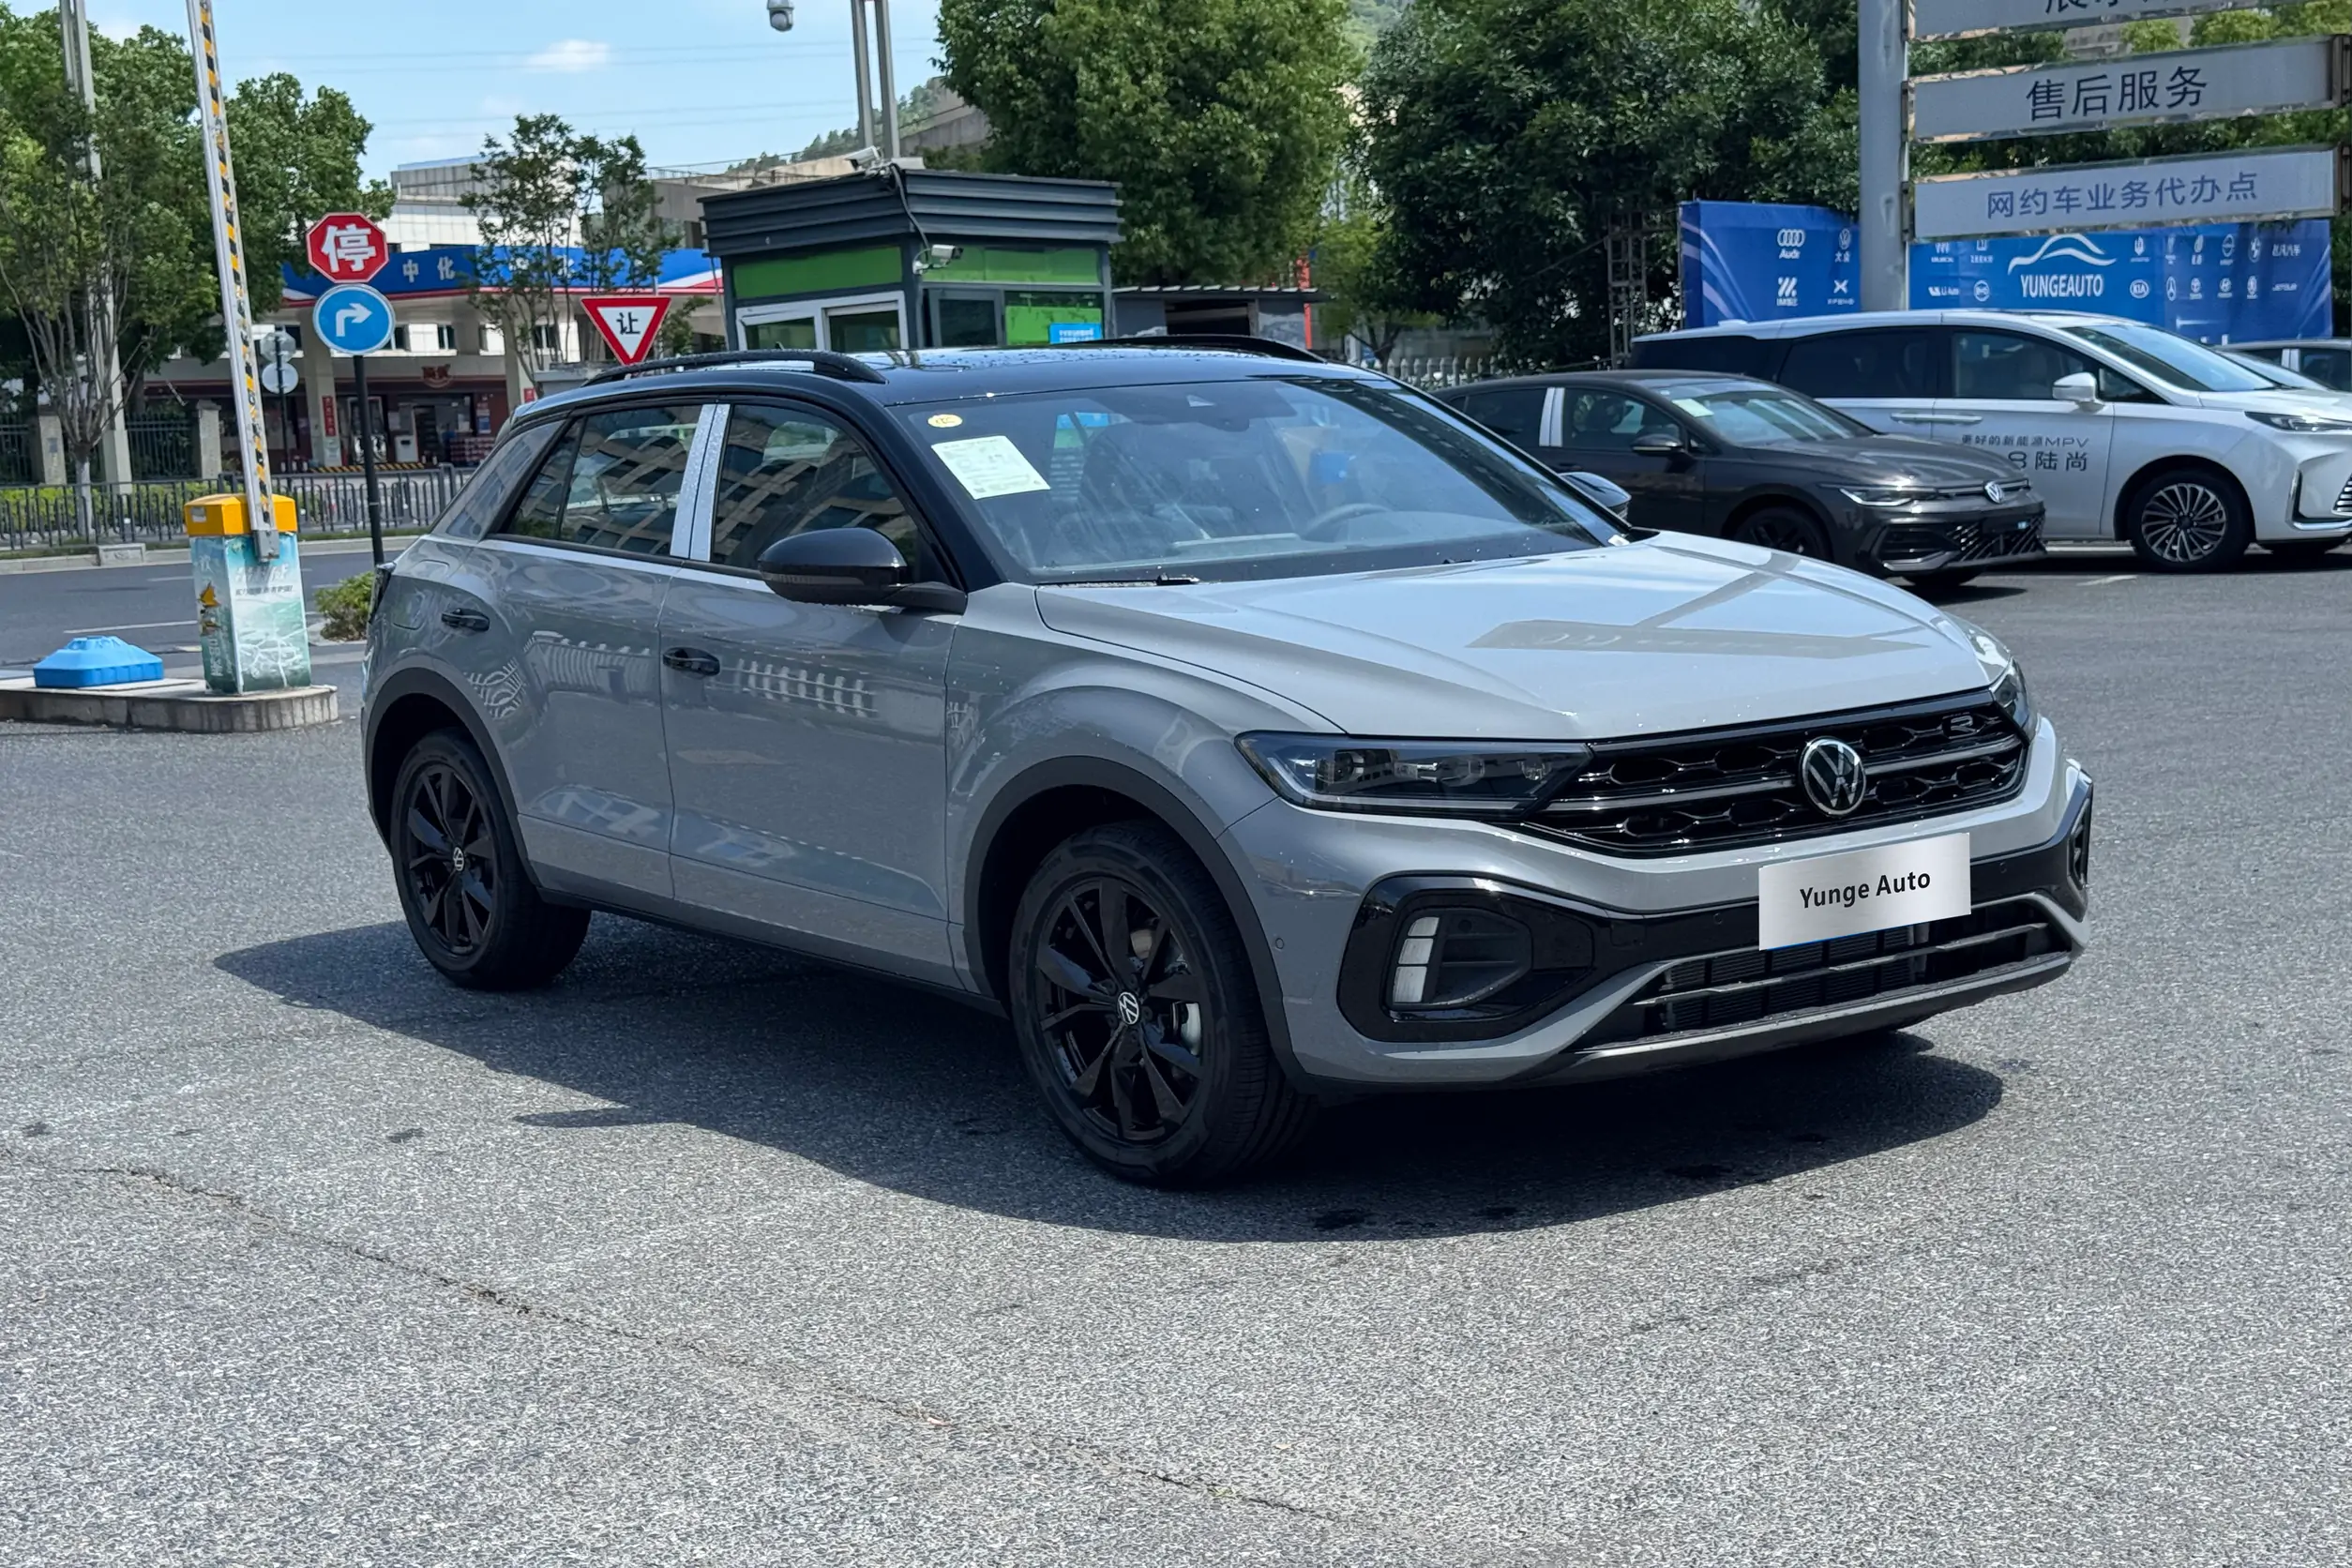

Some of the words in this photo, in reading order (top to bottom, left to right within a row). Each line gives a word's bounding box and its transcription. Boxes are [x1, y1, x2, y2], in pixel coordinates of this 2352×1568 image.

[2026, 66, 2207, 122] 售后服务
[1987, 172, 2257, 219] 网约车业务代办点
[322, 223, 376, 273] 停
[403, 256, 456, 282] 中化
[2020, 274, 2104, 298] YUNGEAUTO
[617, 311, 640, 336] 让
[1800, 882, 1869, 909] Yunge
[1876, 871, 1930, 897] Auto
